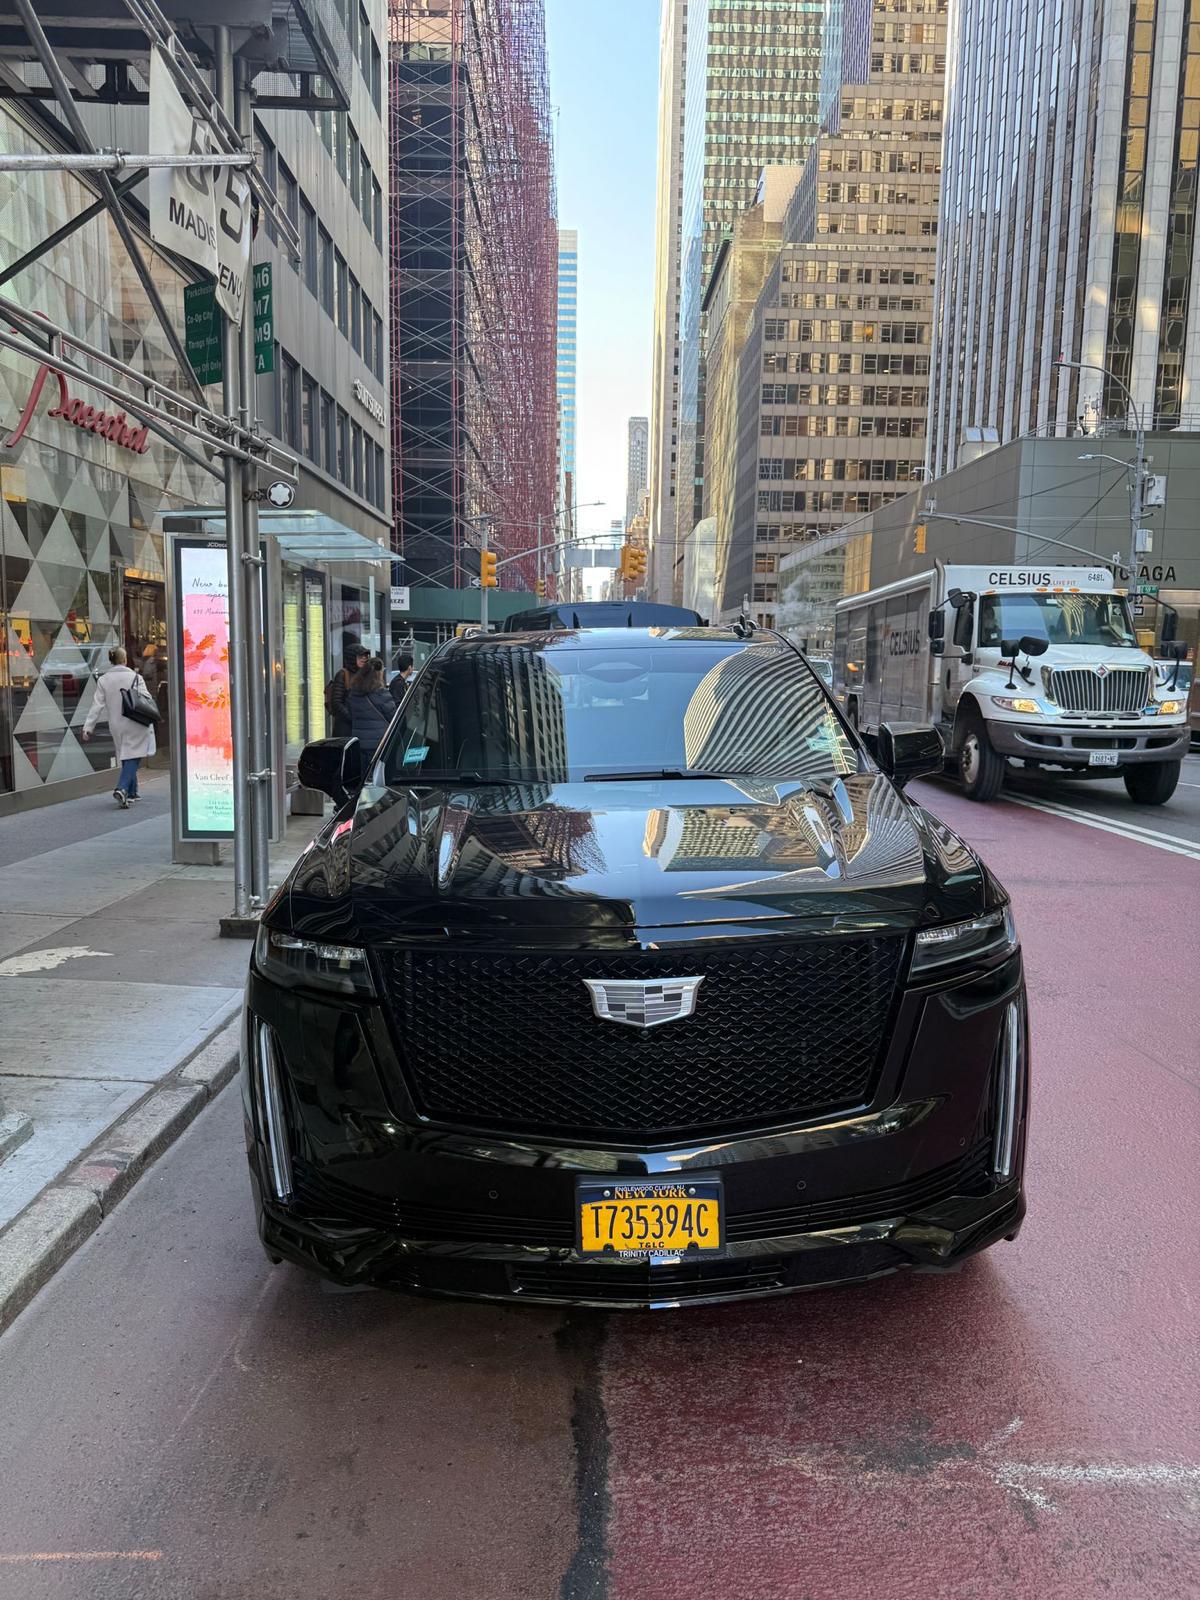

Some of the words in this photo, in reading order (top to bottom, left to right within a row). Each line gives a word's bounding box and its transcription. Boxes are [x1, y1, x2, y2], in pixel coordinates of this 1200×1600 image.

[890, 629, 920, 656] CELSIUS
[614, 1189, 647, 1200] NEW
[652, 1188, 688, 1199] YORK
[590, 1203, 709, 1240] T735394C
[618, 1250, 648, 1259] TRINITY
[648, 1249, 685, 1258] CADILLAC
